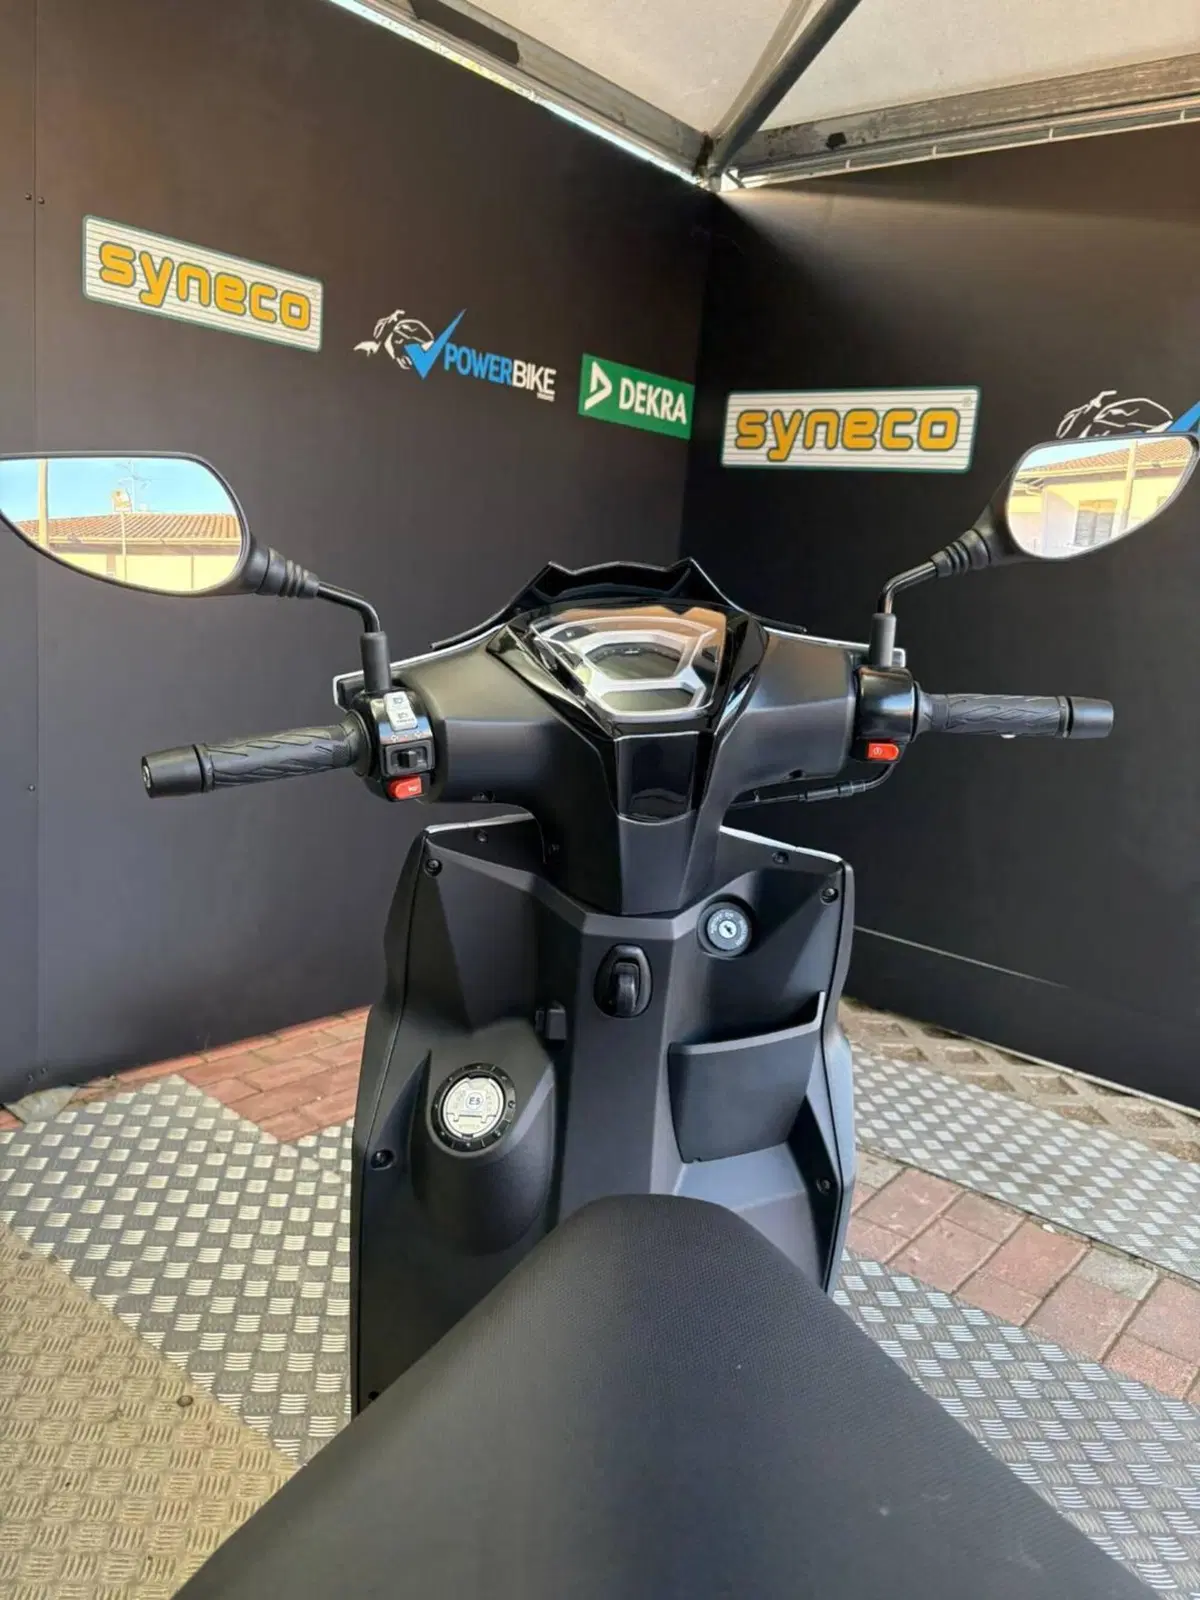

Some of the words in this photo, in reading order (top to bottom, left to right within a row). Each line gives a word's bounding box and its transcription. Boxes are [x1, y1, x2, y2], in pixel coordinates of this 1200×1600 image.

[99, 241, 311, 331] syneco
[443, 343, 557, 395] POWERBIKE
[618, 377, 688, 425] DEKRA
[734, 407, 961, 462] syneco
